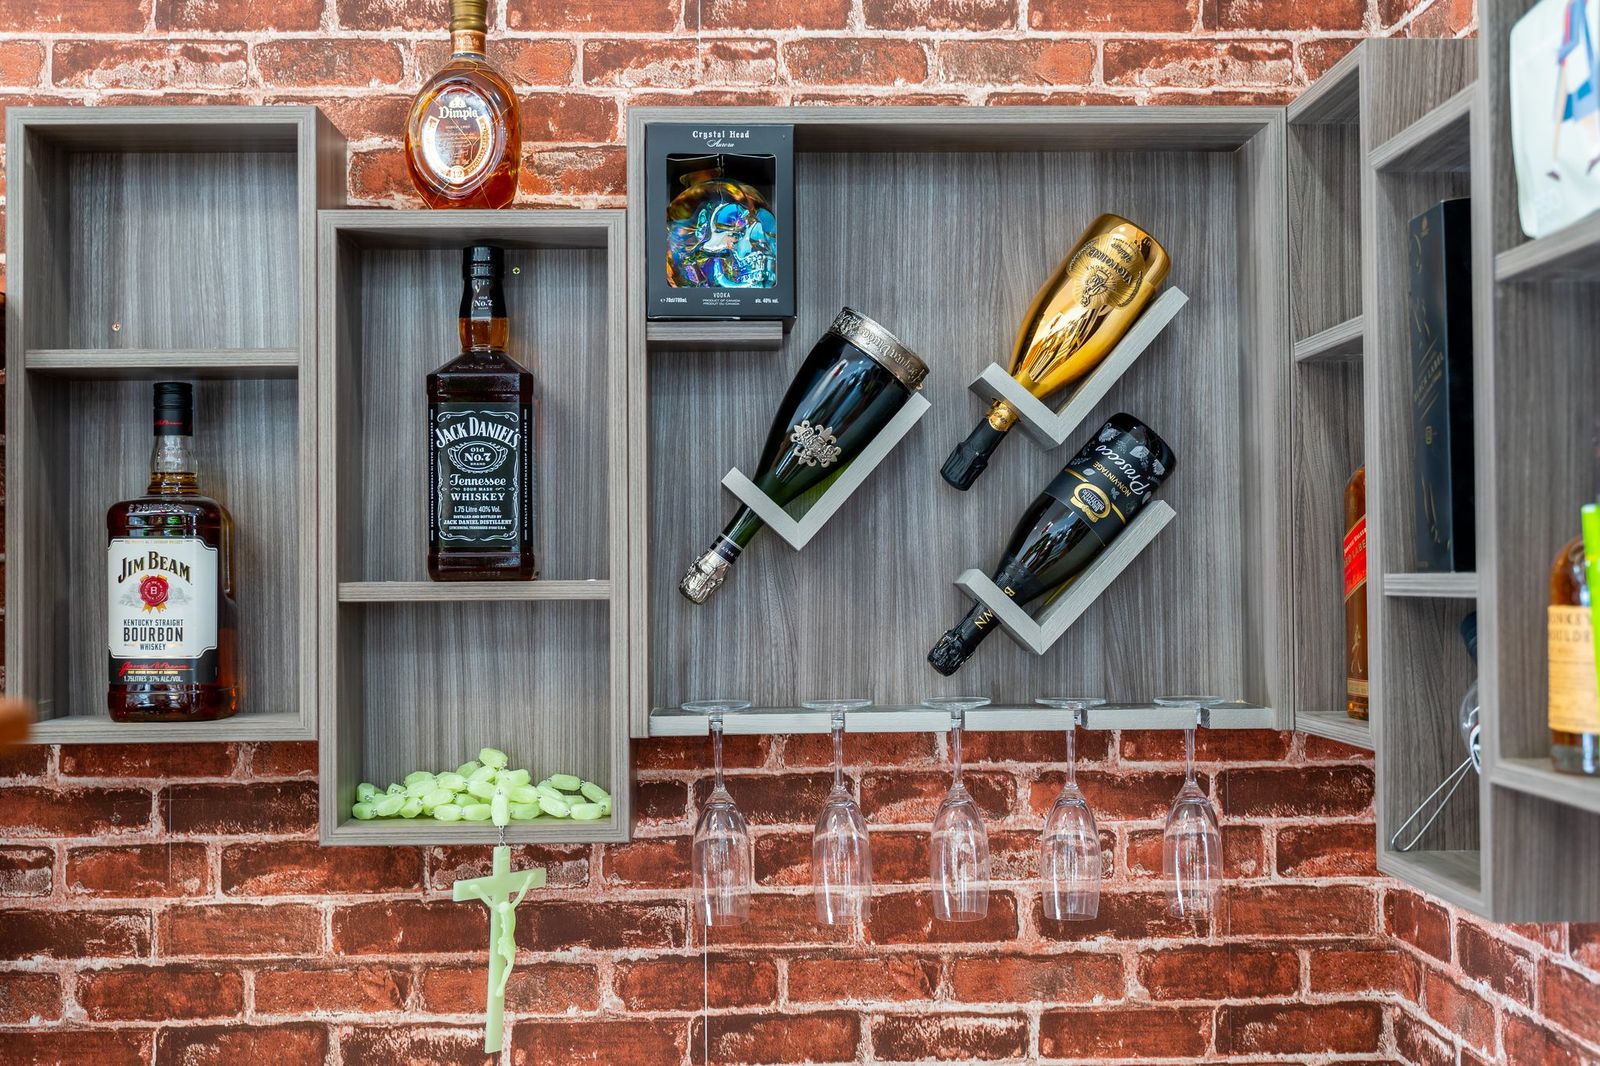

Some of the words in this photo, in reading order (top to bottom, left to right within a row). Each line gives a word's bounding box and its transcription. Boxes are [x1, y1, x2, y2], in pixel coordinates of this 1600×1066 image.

[438, 105, 478, 120] Dimple
[692, 130, 725, 140] Crystal
[729, 130, 750, 138] Head
[434, 422, 469, 448] JACK
[464, 453, 491, 461] No.7
[1095, 444, 1151, 496] Prosecco
[450, 474, 506, 486] Tennessee
[1093, 461, 1132, 497] NON-VINTAGE
[451, 493, 506, 501] WHISKEY
[117, 556, 145, 583] JIM
[148, 551, 191, 583] BEAM
[123, 627, 183, 642] BOURBON
